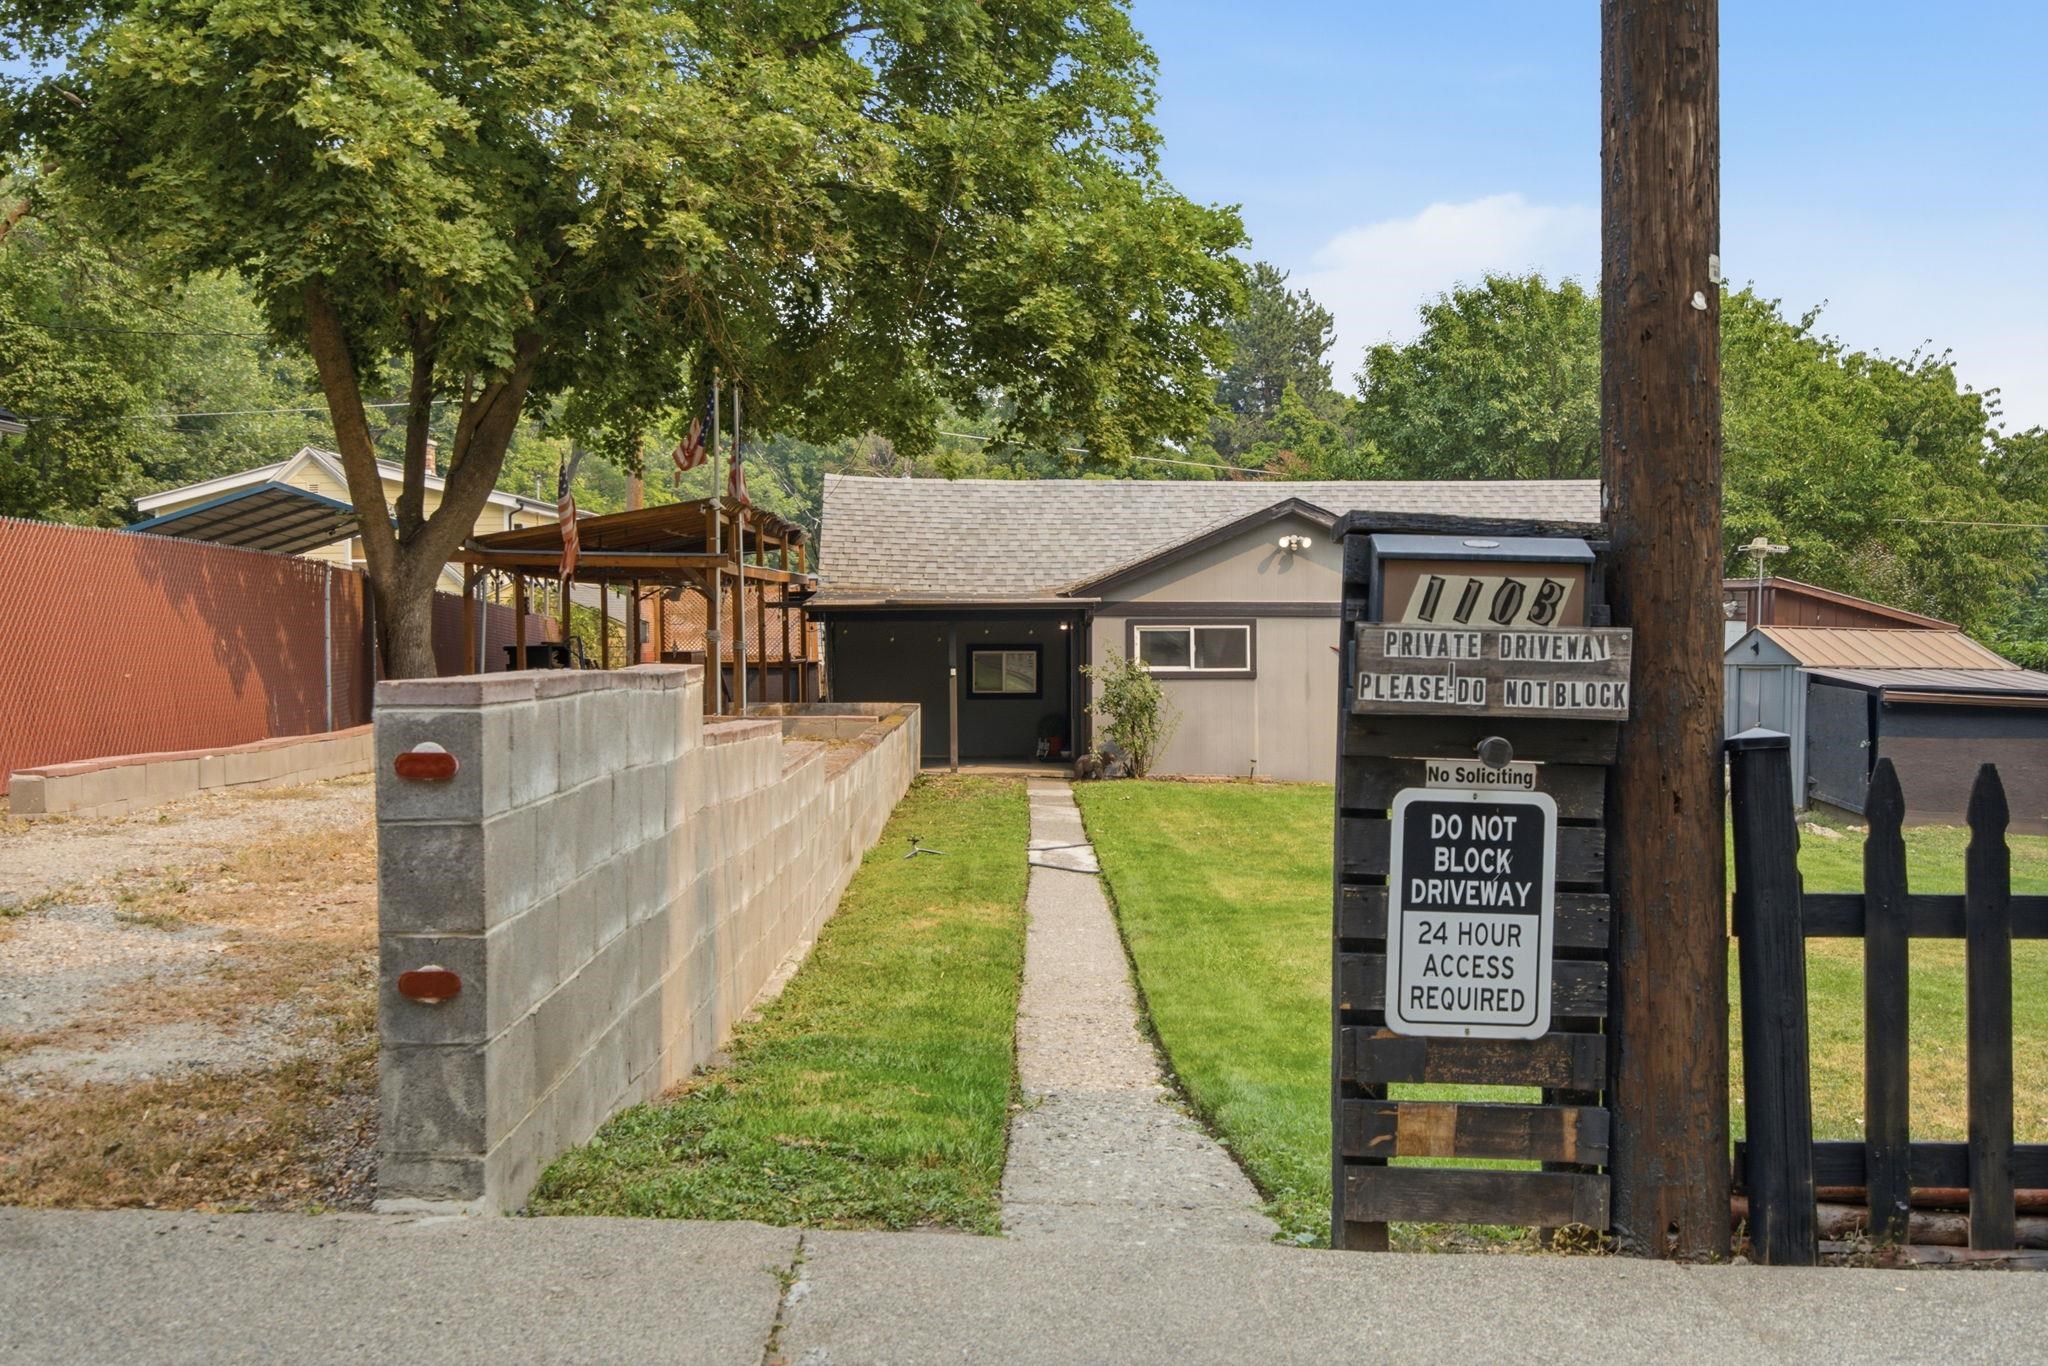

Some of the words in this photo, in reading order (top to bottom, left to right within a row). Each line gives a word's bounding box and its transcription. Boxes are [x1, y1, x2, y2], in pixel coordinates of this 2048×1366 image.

[1418, 575, 1566, 626] 1103
[1386, 631, 1478, 658] PRIVATE
[1500, 634, 1606, 660] DRIVEWAY
[1506, 681, 1547, 706] NOT
[1555, 682, 1626, 708] BLOCK
[1427, 766, 1450, 782] No
[1455, 767, 1533, 788] Soliciting
[1431, 814, 1462, 839] DO
[1471, 815, 1517, 841] NOT
[1434, 846, 1511, 874] BLOCK
[1410, 878, 1532, 907] DRIVEWAY
[1418, 921, 1448, 944] 24
[1458, 922, 1522, 947] HOUR
[1423, 954, 1514, 979] ACCESS
[1410, 986, 1525, 1012] REQUIRED
